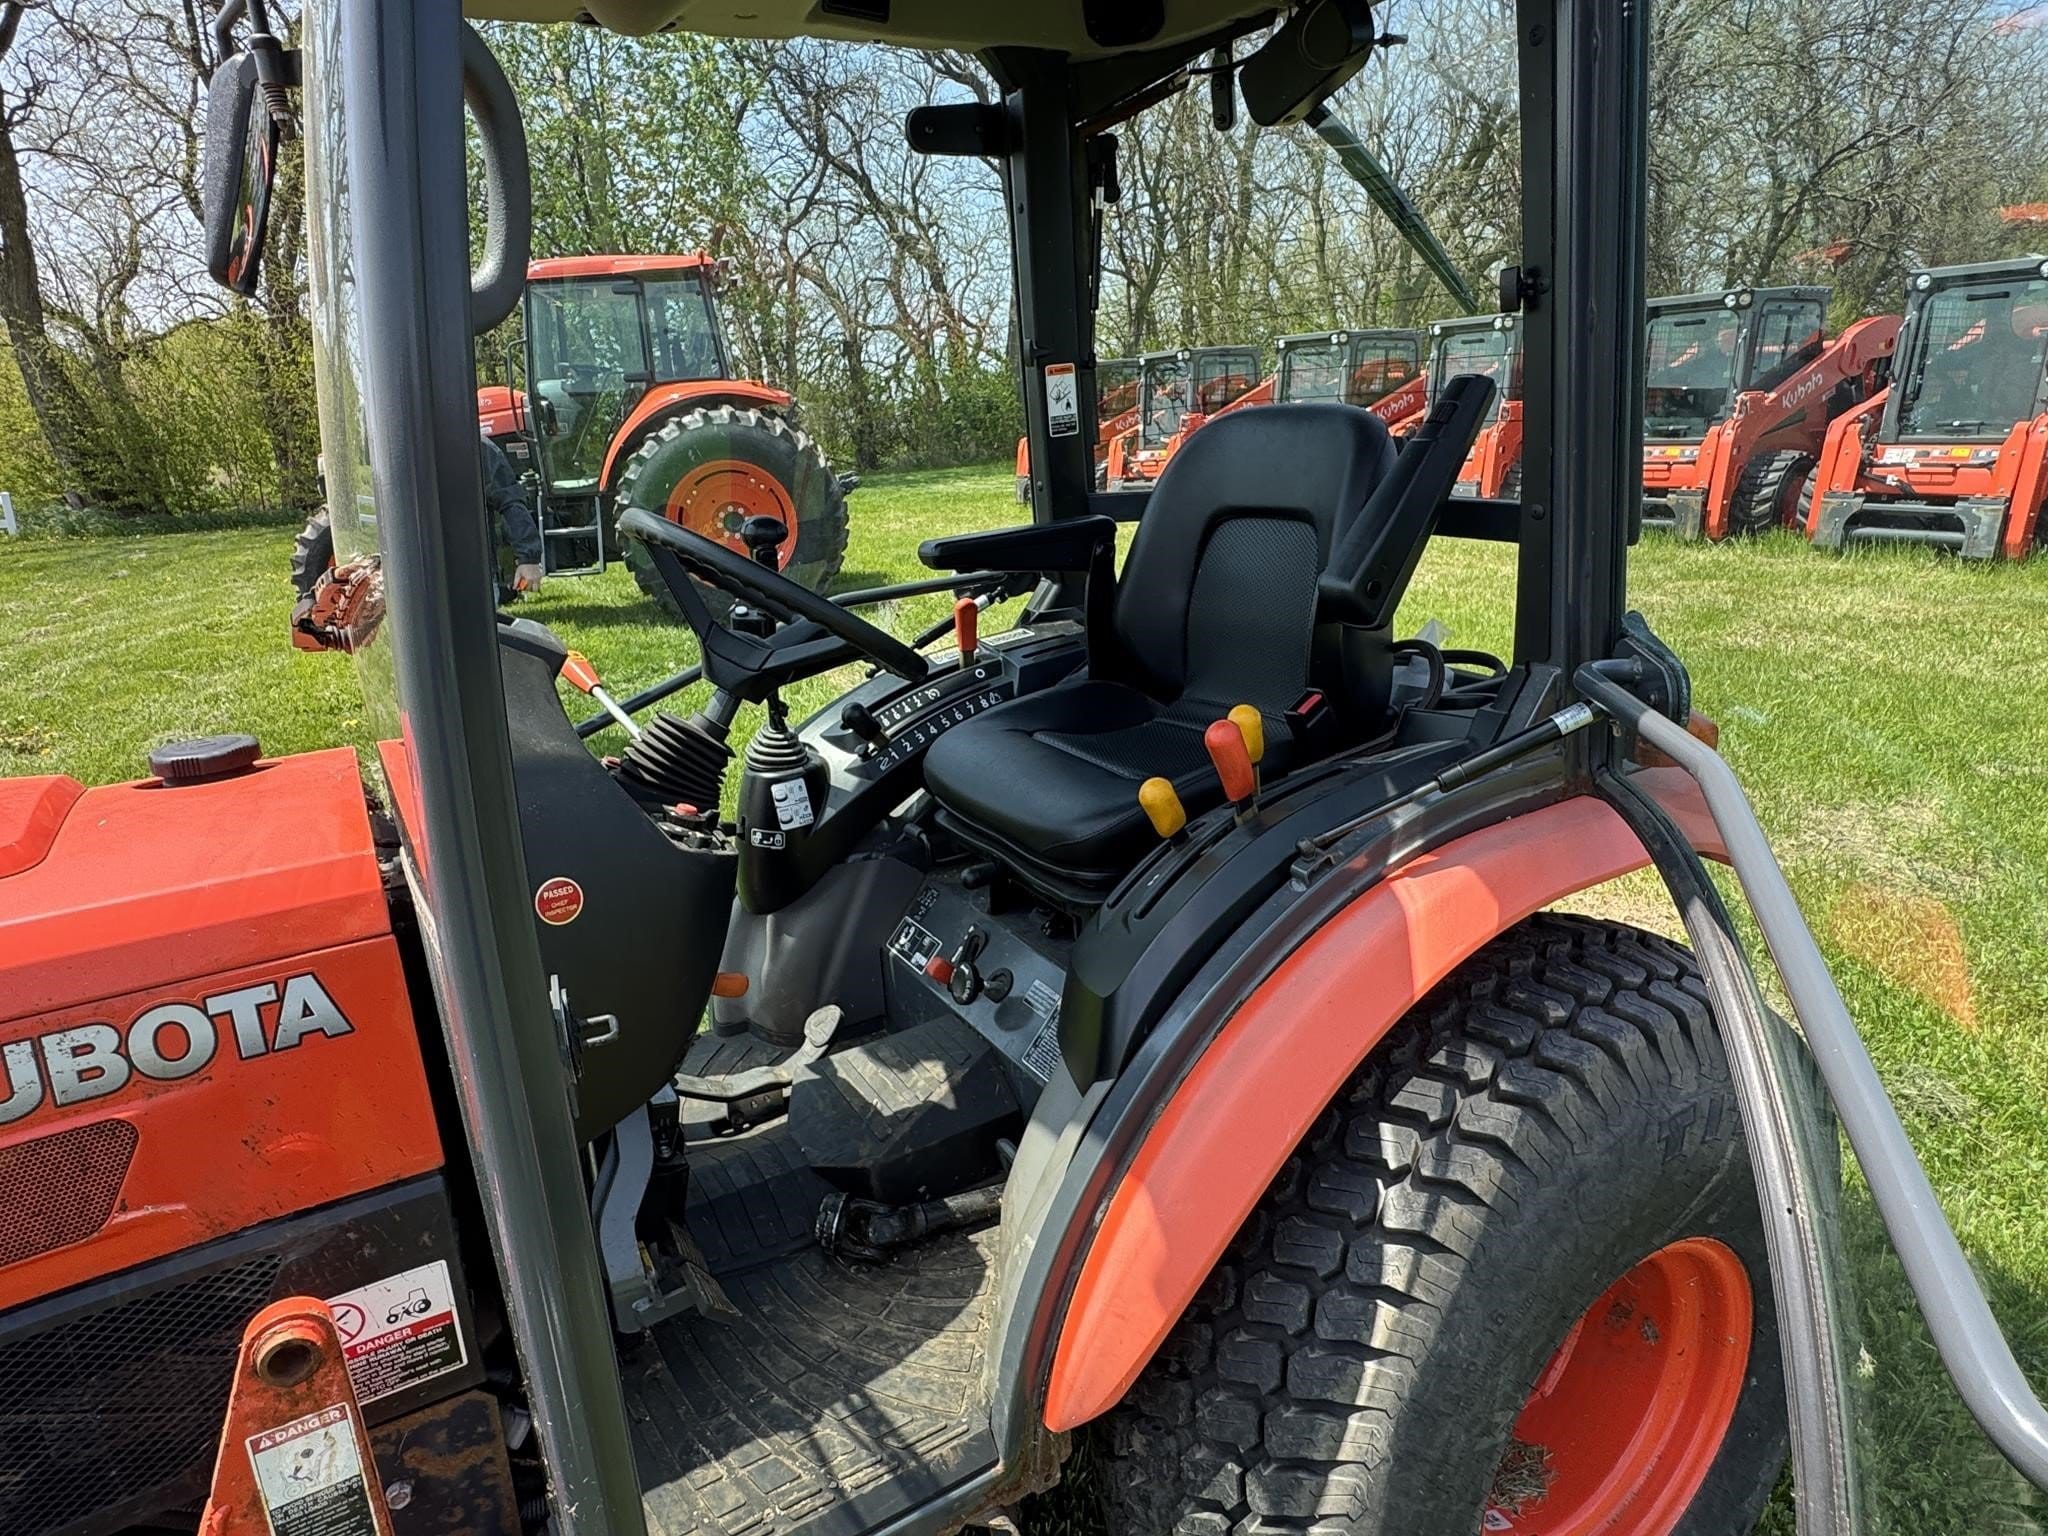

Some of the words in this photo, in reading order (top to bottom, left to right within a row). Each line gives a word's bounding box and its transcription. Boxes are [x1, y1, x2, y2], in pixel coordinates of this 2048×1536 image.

[1782, 373, 1823, 408] Kubota
[1376, 393, 1414, 419] Kubota
[890, 750, 900, 760] 1
[903, 742, 913, 752] 2
[915, 733, 925, 743] 3
[929, 725, 938, 735] 4
[940, 718, 951, 728] 5
[954, 711, 964, 721] 6
[966, 705, 975, 714] 7
[980, 698, 989, 708] 8
[543, 886, 574, 900] PASSED
[0, 971, 355, 1126] UBOTA
[355, 1326, 412, 1354] DANGER
[417, 1327, 442, 1339] DEATH
[274, 1409, 341, 1442] DANGER
